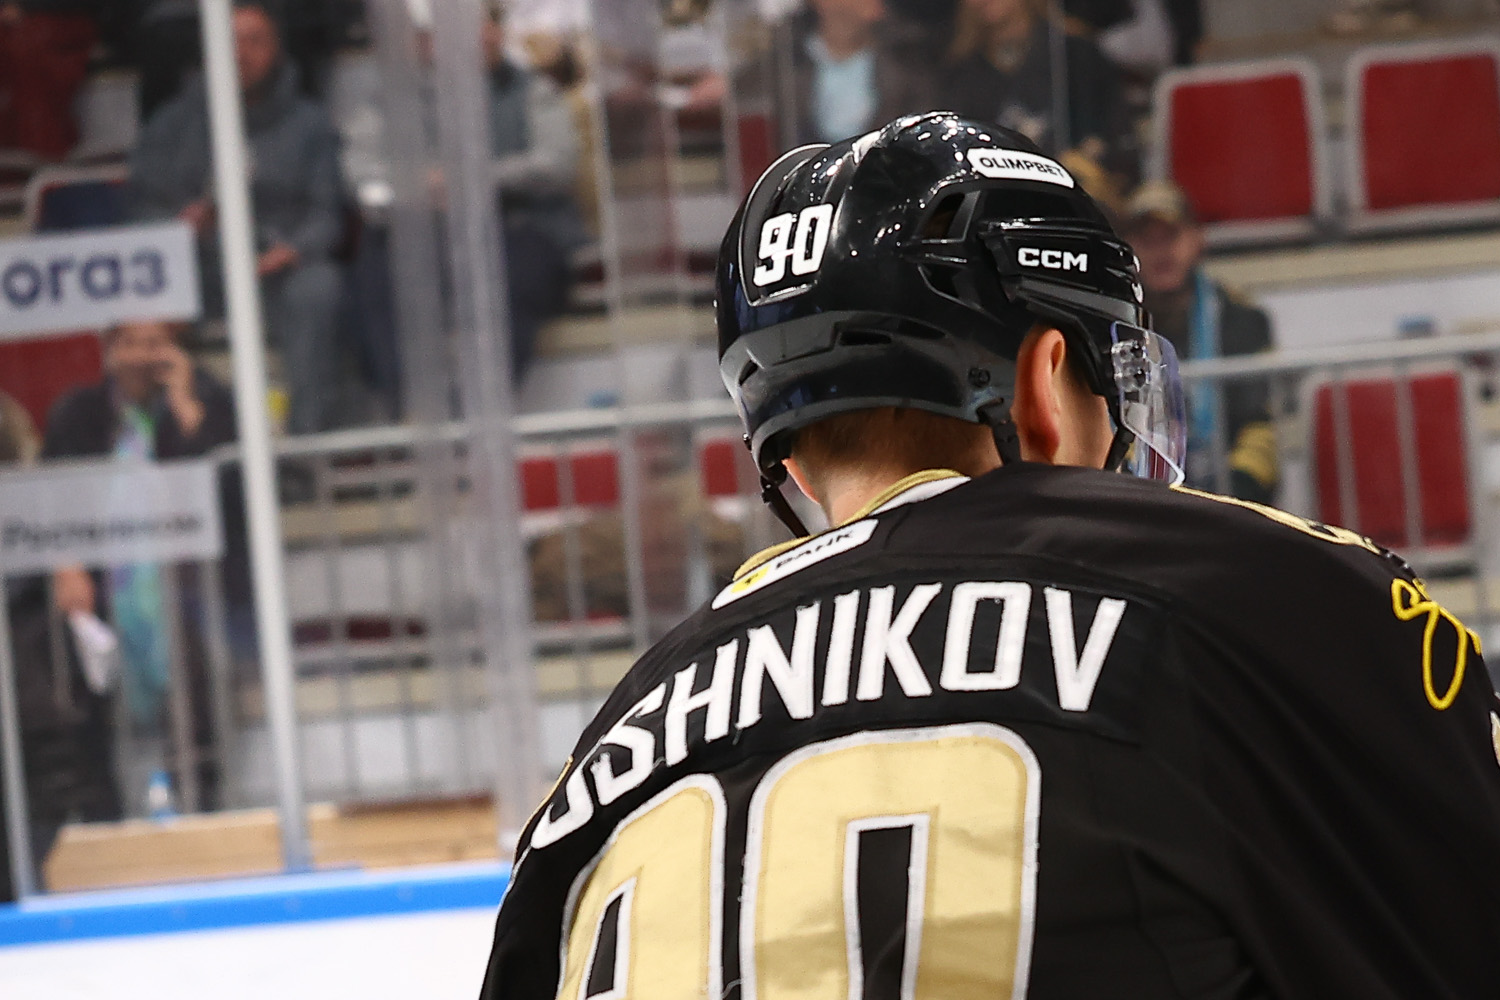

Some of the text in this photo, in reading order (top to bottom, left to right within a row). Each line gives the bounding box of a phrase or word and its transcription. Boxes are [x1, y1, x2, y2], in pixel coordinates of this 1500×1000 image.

[979, 157, 1065, 178] OLIMPBET
[753, 204, 833, 286] 90
[1018, 248, 1088, 273] CCM
